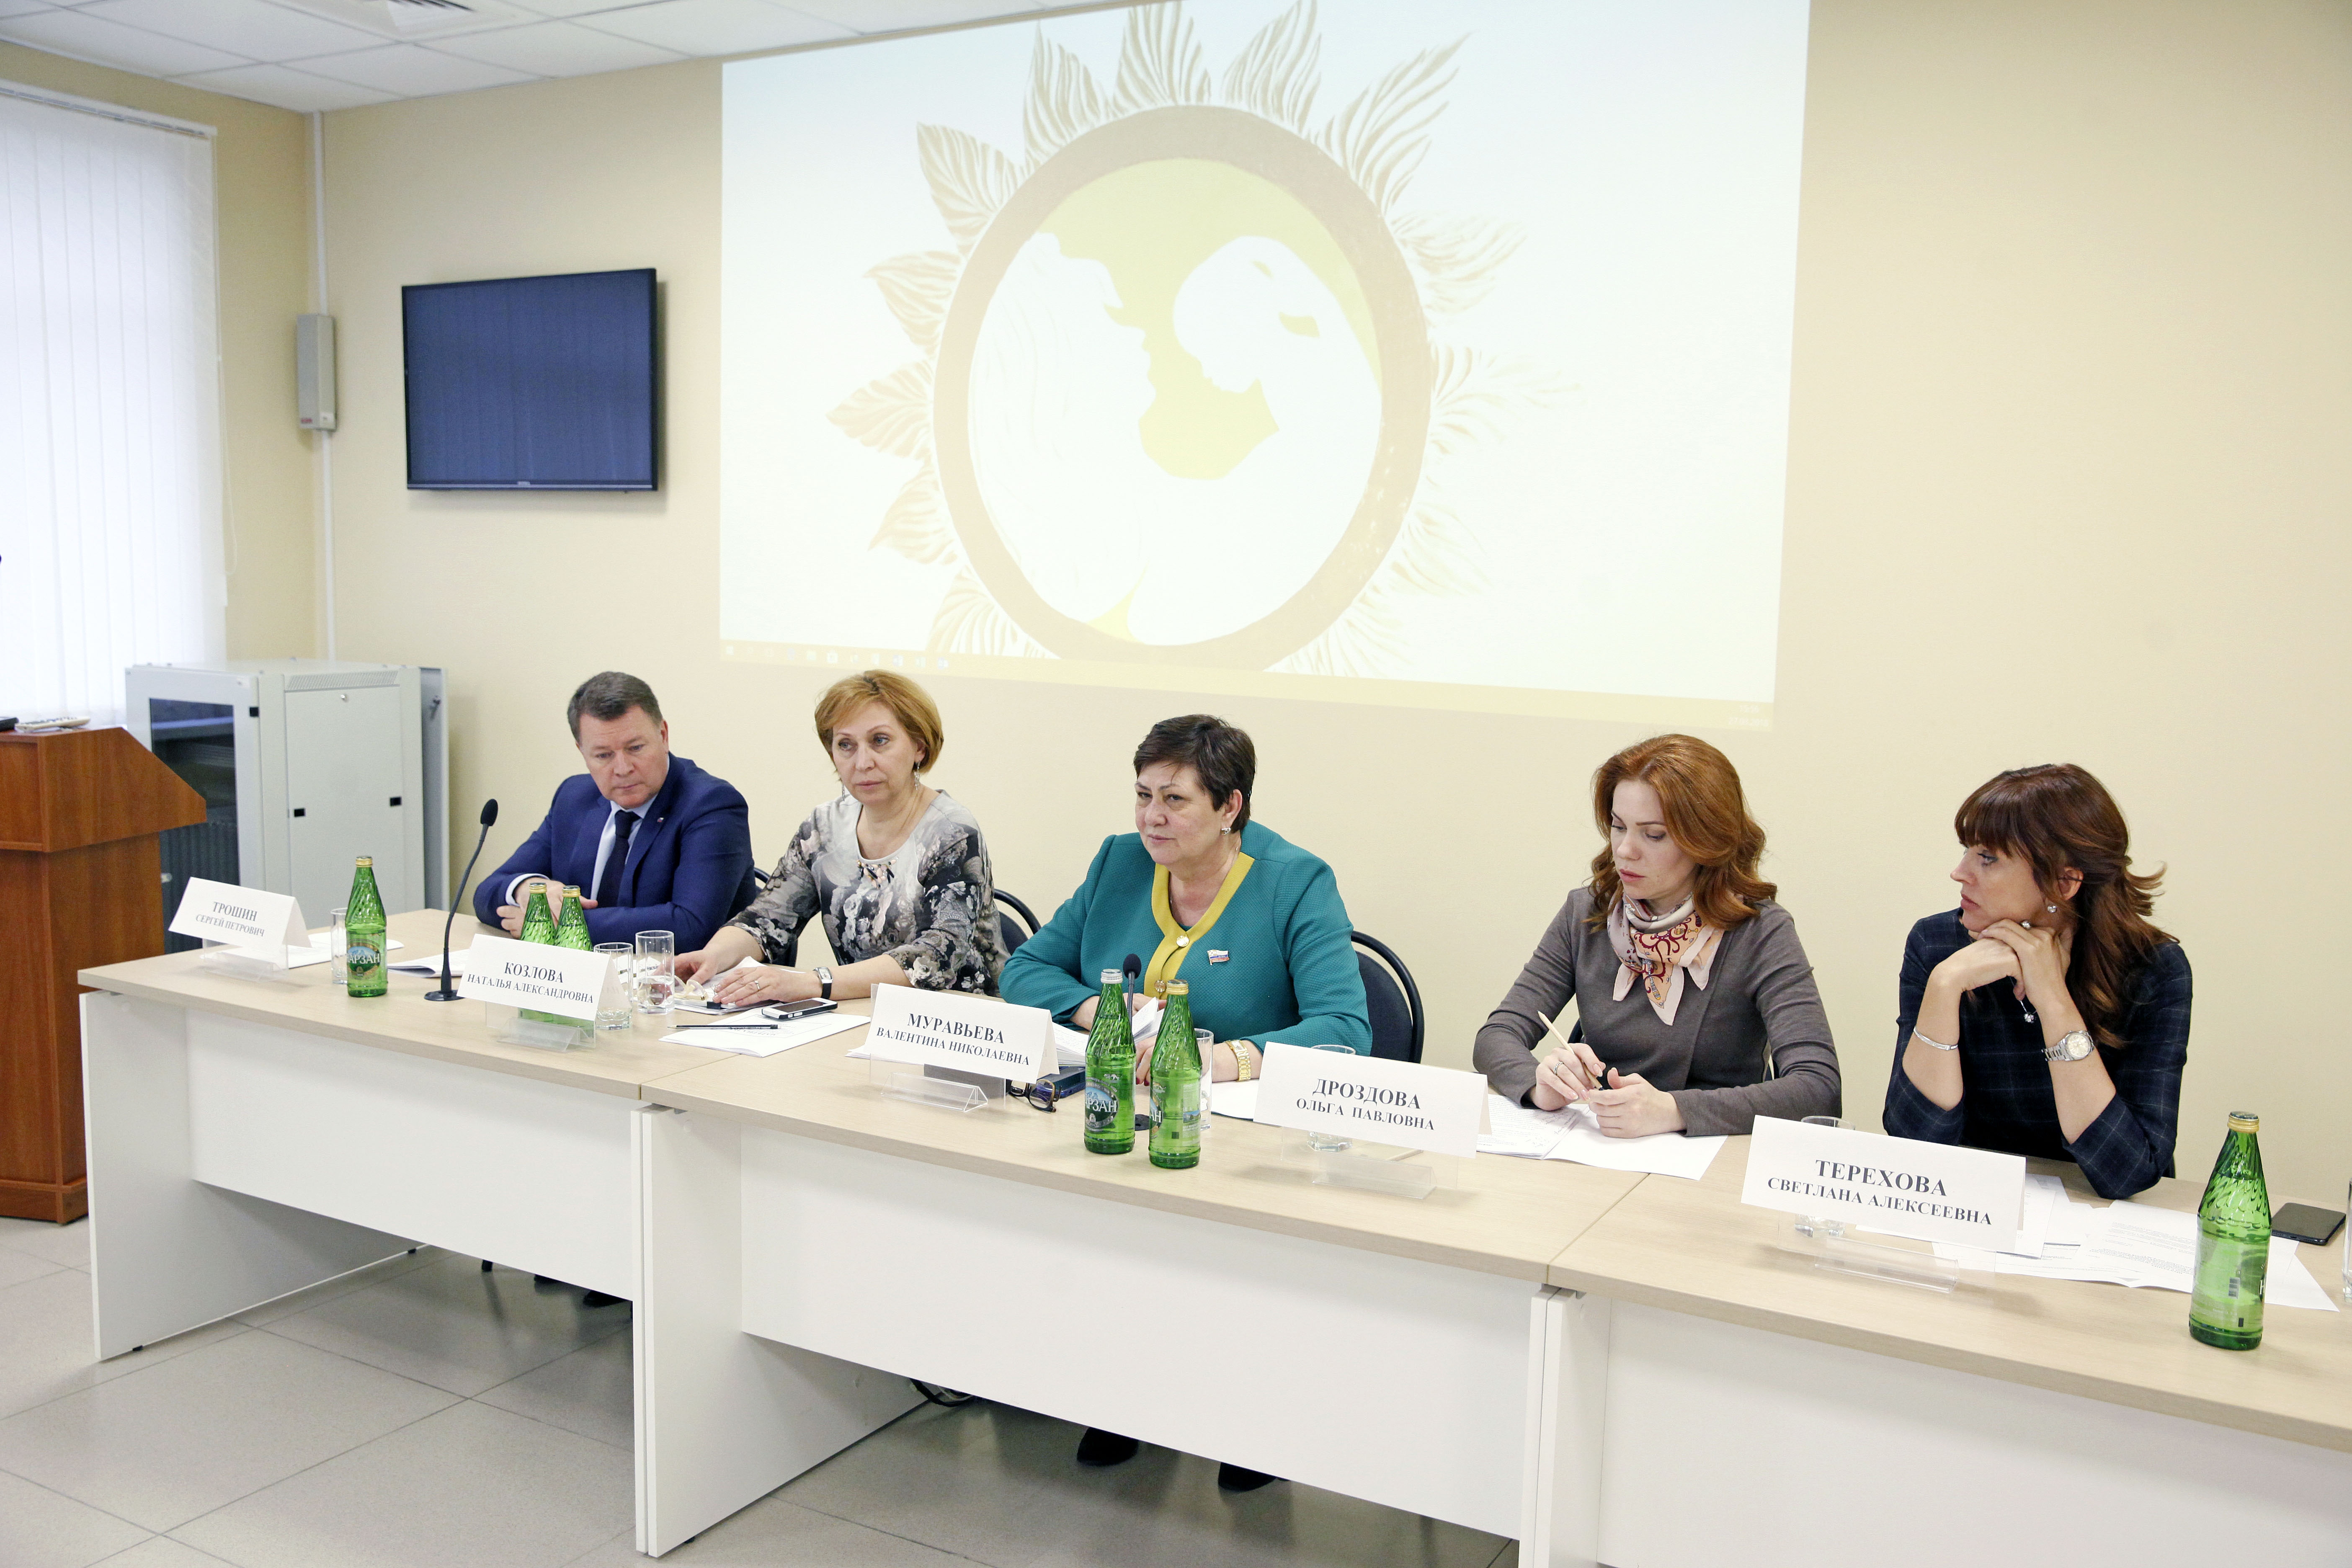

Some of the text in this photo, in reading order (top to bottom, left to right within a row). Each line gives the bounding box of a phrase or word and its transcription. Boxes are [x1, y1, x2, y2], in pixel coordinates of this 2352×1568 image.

[196, 914, 264, 936] СЕРГЕЙ ПЕТРОВИЧ
[213, 901, 257, 921] ТРОШИН
[504, 962, 563, 983] КОЗЛОВА
[467, 974, 593, 1003] НАТАЛЬЯ АЛЕКСАНДРОВНА
[907, 1013, 1004, 1044] МУРАВЬЕВА
[877, 1027, 1029, 1065] ВАЛЕНТИНА НИКОЛАЕВНА
[1312, 1078, 1421, 1109] ДРОЗДОВА
[1296, 1098, 1434, 1130] ОЛЬГА ПАВЛОВНА
[1816, 1160, 1947, 1197] ТЕРЕХОВА
[1768, 1177, 1992, 1225] СВЕТЛАНА АЛЕКСЕЕВНА
